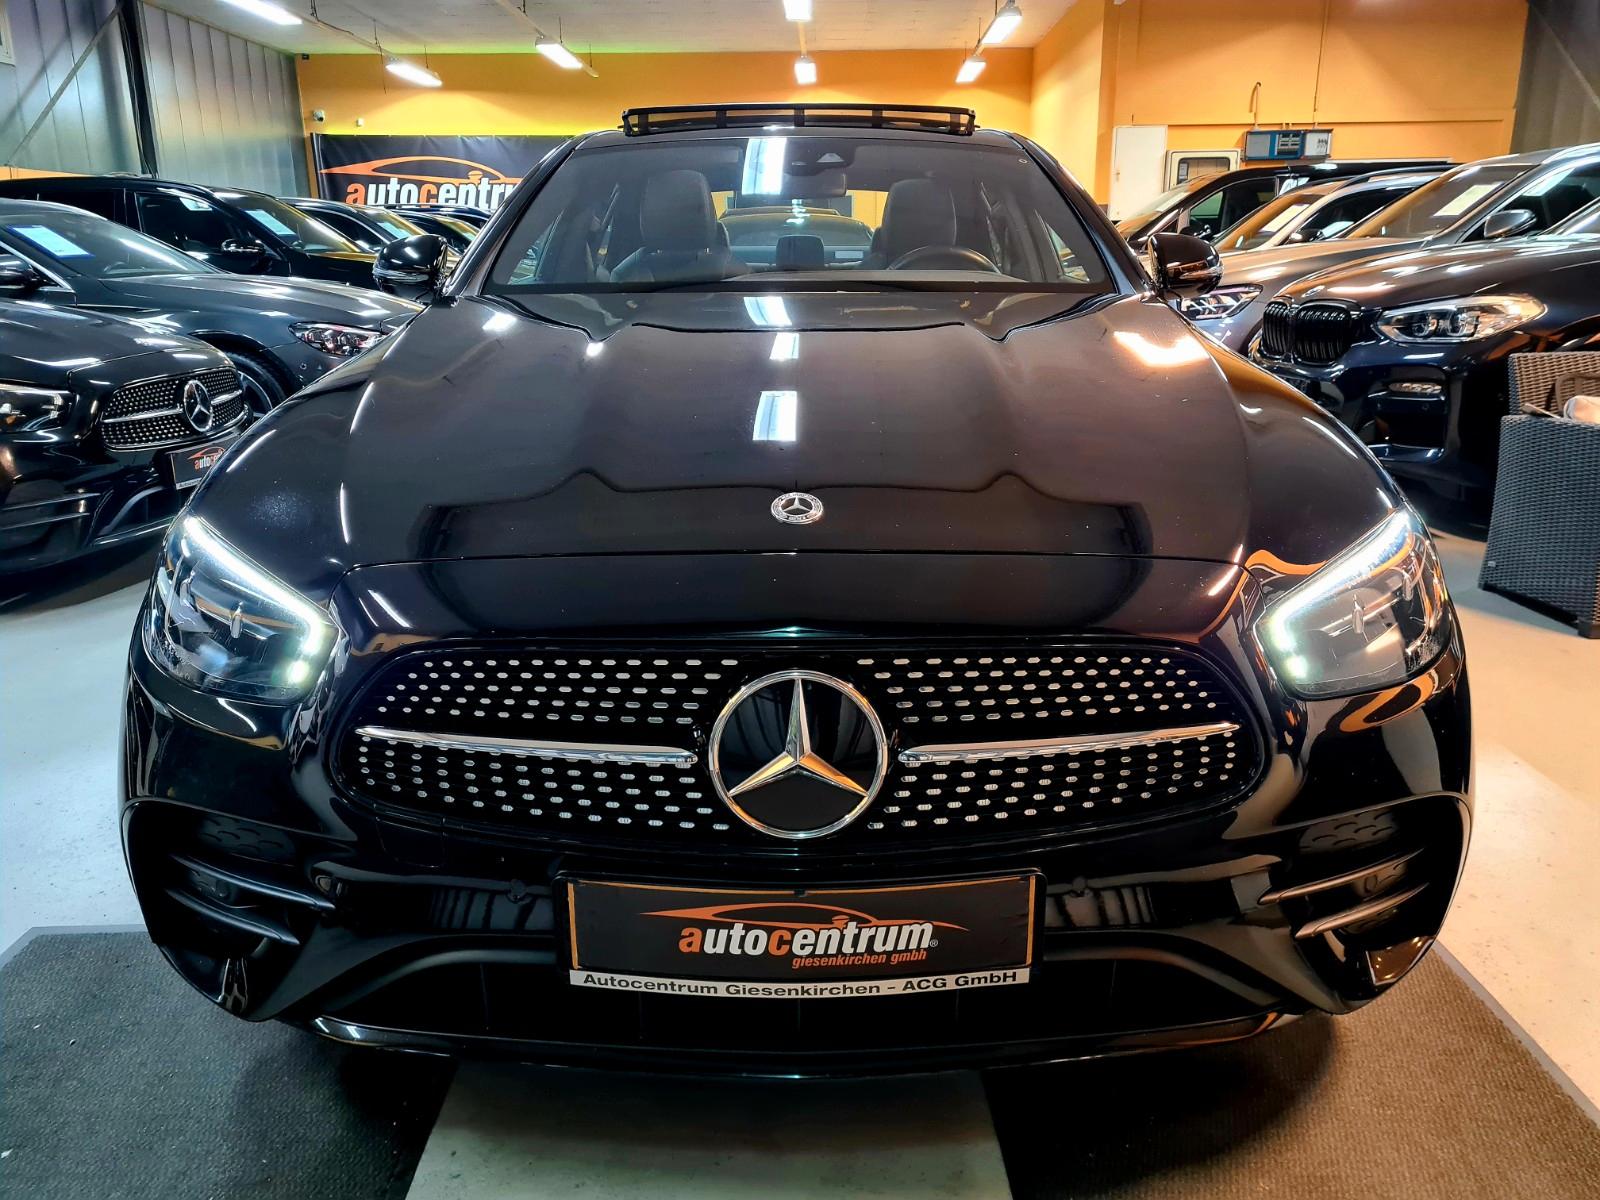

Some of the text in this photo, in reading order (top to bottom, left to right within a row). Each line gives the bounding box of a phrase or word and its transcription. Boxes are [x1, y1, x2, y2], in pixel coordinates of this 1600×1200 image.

[792, 950, 927, 969] giesenkirchen gmbh
[583, 974, 718, 995] Autocentrum
[725, 982, 880, 997] Giesenkirchen
[903, 977, 947, 991] ACG
[954, 972, 1017, 987] GmbH
